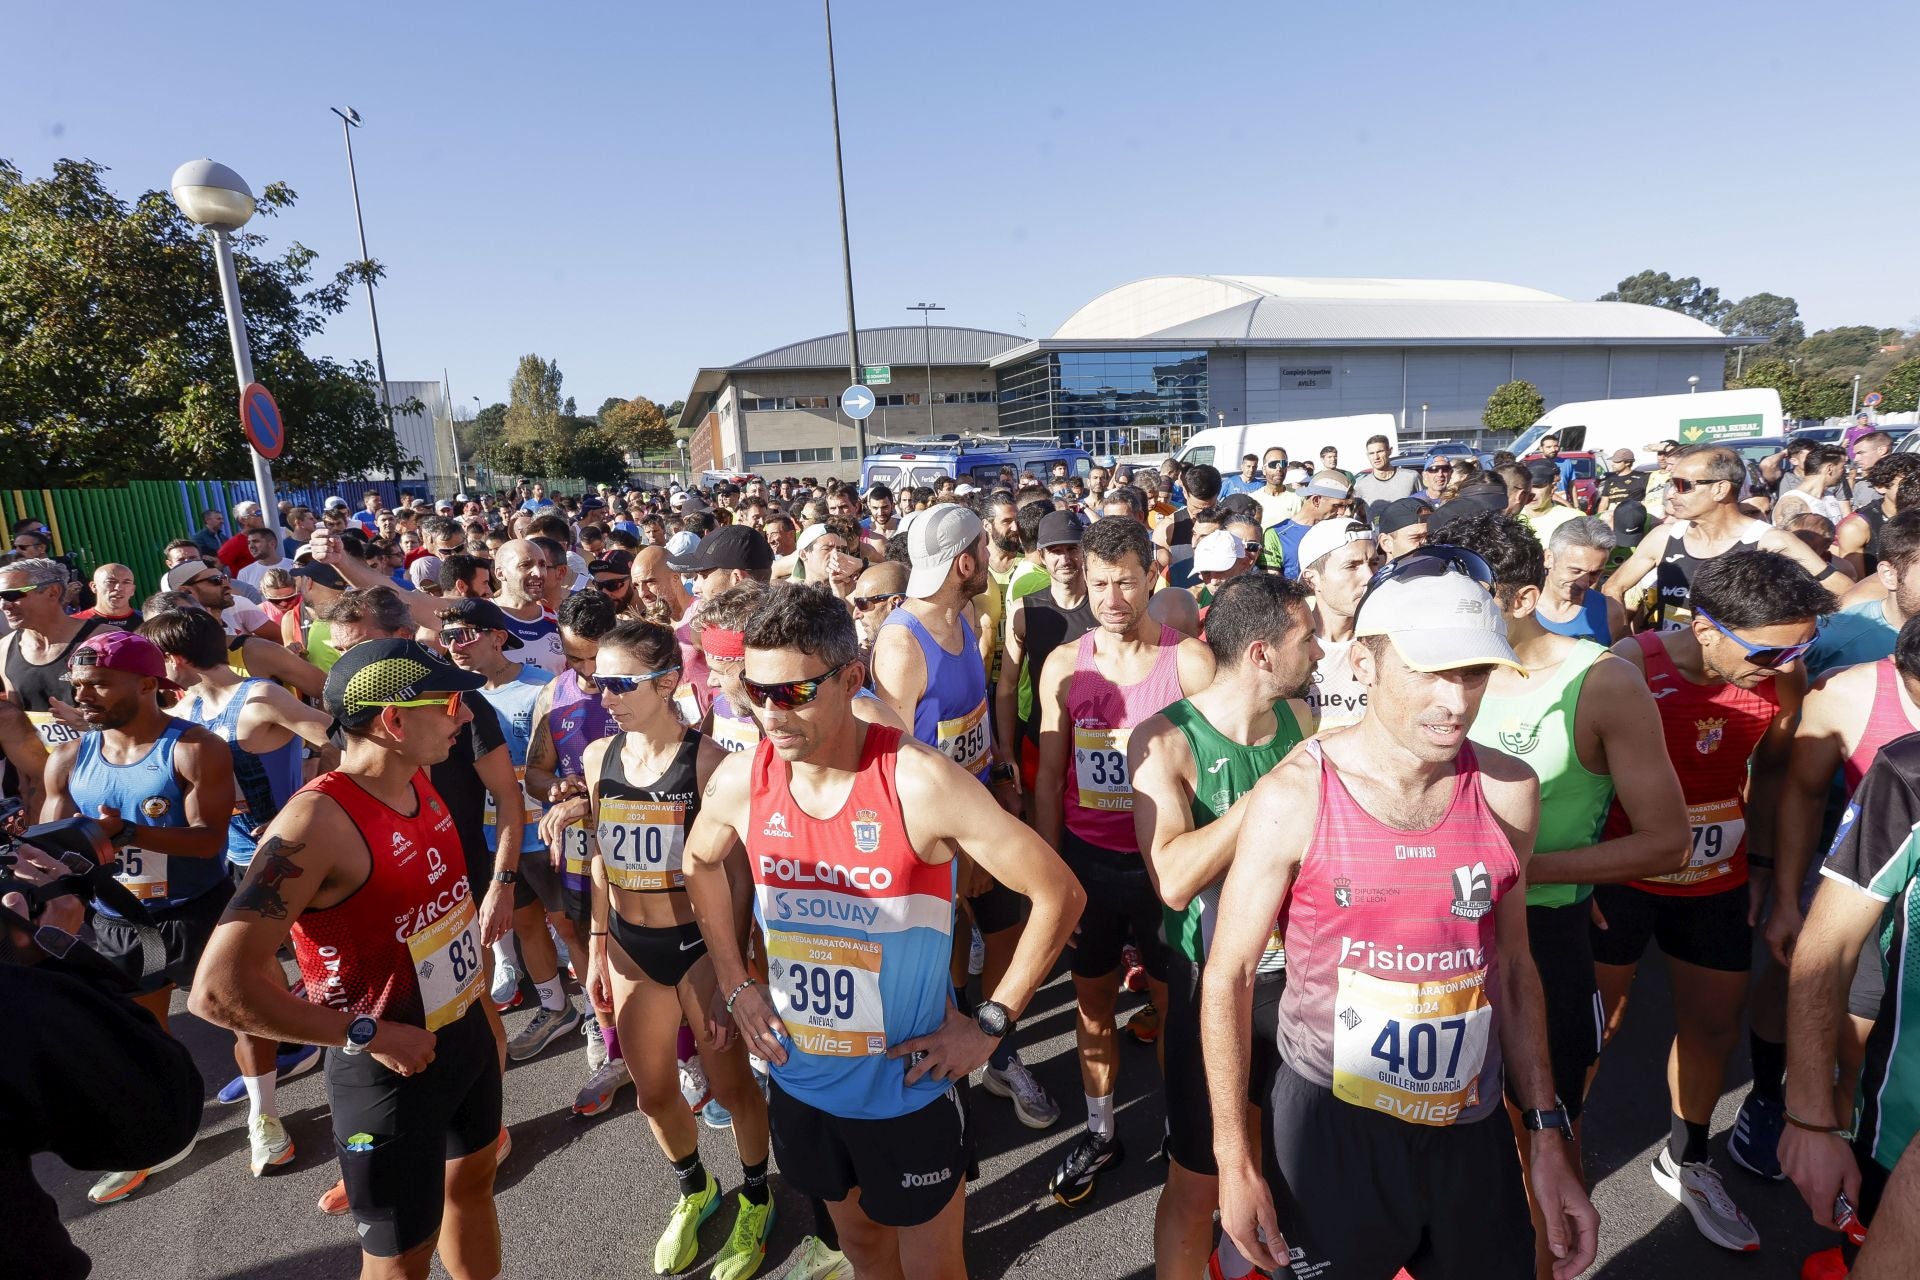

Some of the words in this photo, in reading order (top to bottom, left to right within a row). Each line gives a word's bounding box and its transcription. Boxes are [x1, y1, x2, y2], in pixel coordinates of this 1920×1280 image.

[1704, 425, 1727, 434] CAJA
[1728, 423, 1760, 432] RURAL
[561, 718, 575, 732] kp
[954, 722, 984, 763] 359
[1090, 751, 1131, 785] 33
[666, 792, 694, 801] VICKY
[1107, 785, 1129, 793] CLAUDIO
[627, 813, 646, 821] 2024
[763, 828, 795, 838] austral
[612, 824, 662, 864] 210
[427, 863, 447, 885] Beco
[620, 876, 663, 888] avilés
[1354, 888, 1400, 896] DIPUTACIÓN
[1366, 895, 1387, 903] LEÓN
[795, 898, 880, 926] SOLVAY
[431, 921, 449, 937] MEDIA
[450, 918, 465, 935] 2024
[790, 935, 812, 945] MEDIA
[812, 938, 851, 950] MARATÓN
[852, 942, 879, 954] AVILÉS
[448, 929, 478, 983] 83
[808, 949, 833, 961] 2024
[789, 963, 855, 1020] 399
[1410, 981, 1459, 997] MARATÓN
[1406, 1001, 1439, 1015] 2024
[808, 1015, 834, 1028] ANIEVAS
[793, 1032, 853, 1053] avilés
[1371, 1018, 1467, 1081] 407
[1378, 1070, 1430, 1093] GUILLERMO
[1431, 1077, 1461, 1093] GARCÍA
[1374, 1093, 1461, 1122] avilés
[901, 1167, 952, 1188] Joma
